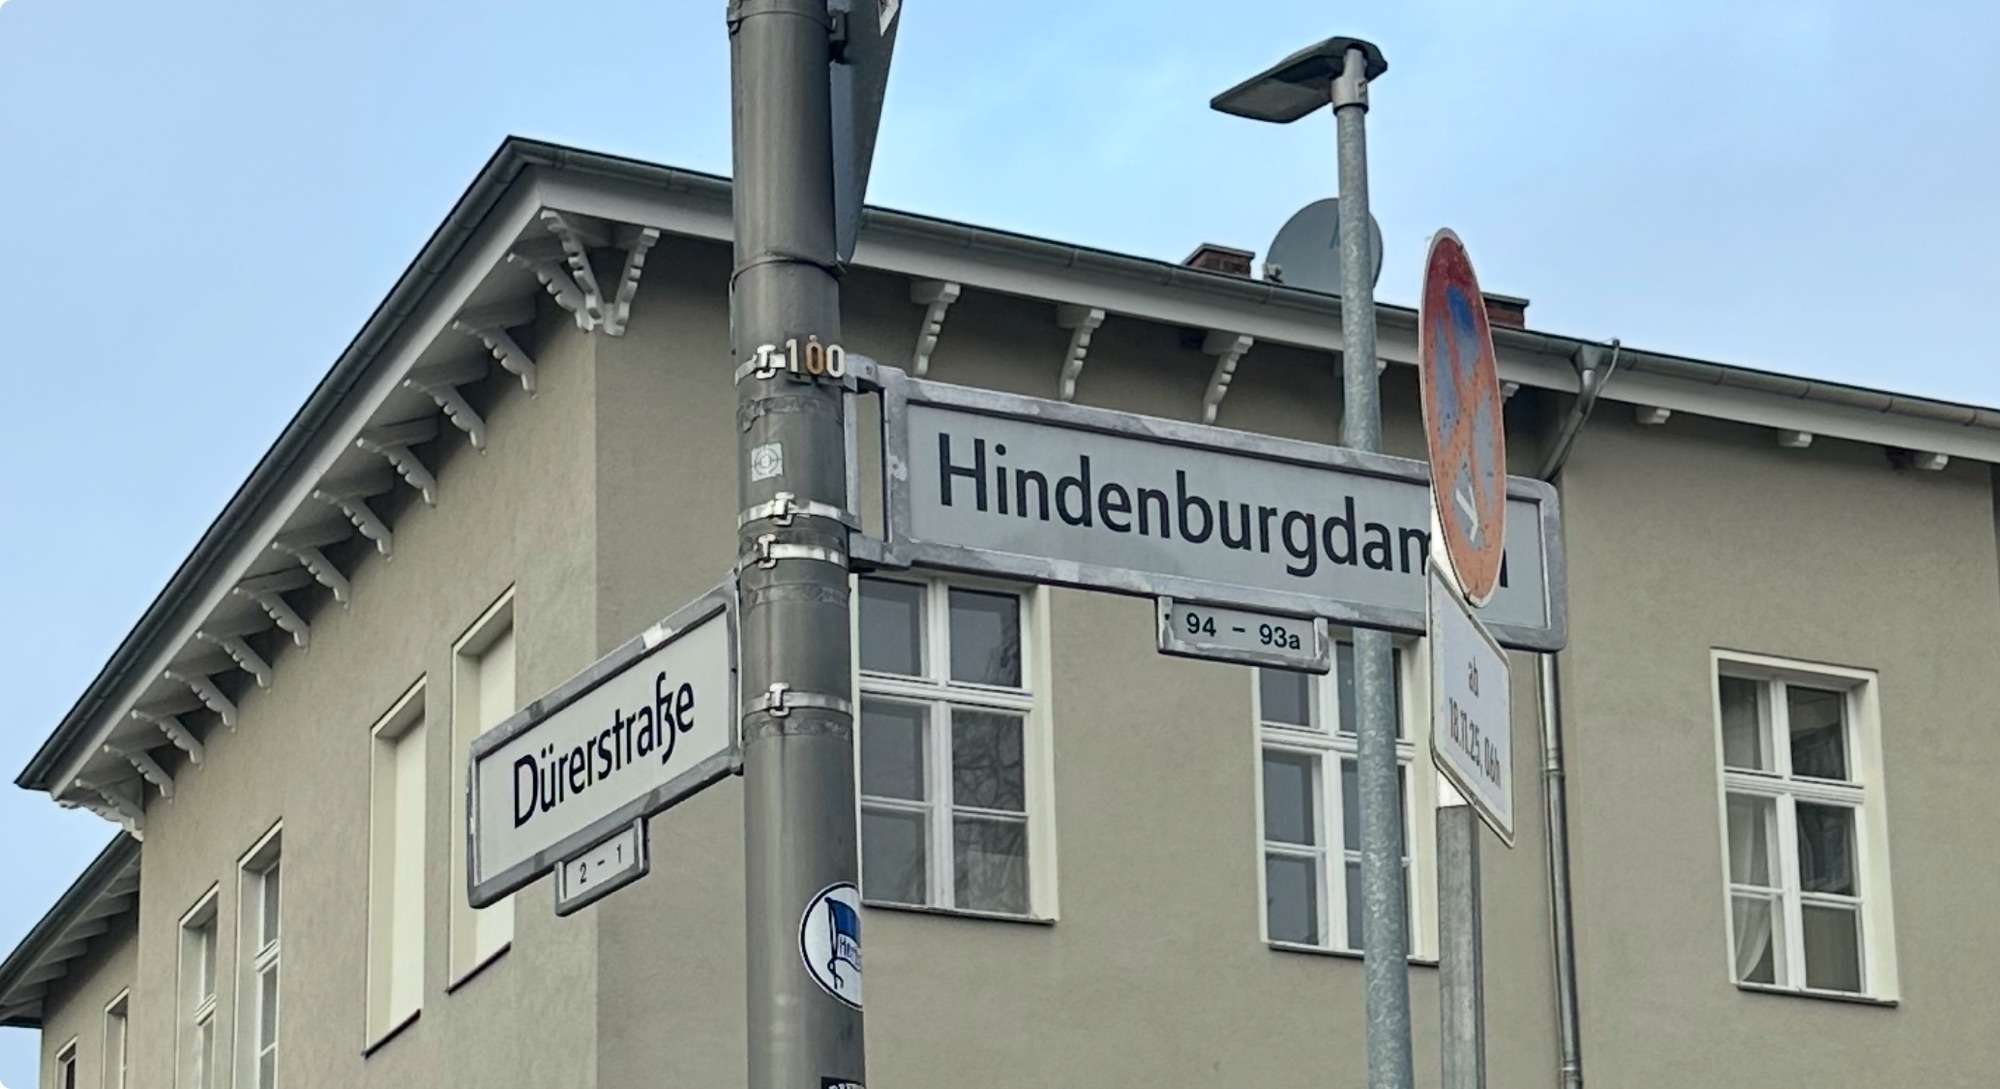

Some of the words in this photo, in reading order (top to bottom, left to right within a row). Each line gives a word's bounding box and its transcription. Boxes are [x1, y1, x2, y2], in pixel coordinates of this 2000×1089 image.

[785, 338, 845, 378] 100
[939, 432, 1508, 588] Hindenburgdam
[1186, 612, 1217, 637] 94
[1259, 623, 1301, 650] 93a
[1468, 656, 1479, 698] ab
[513, 671, 695, 829] Dürerstraße
[580, 862, 588, 884] 2
[616, 844, 622, 864] 1
